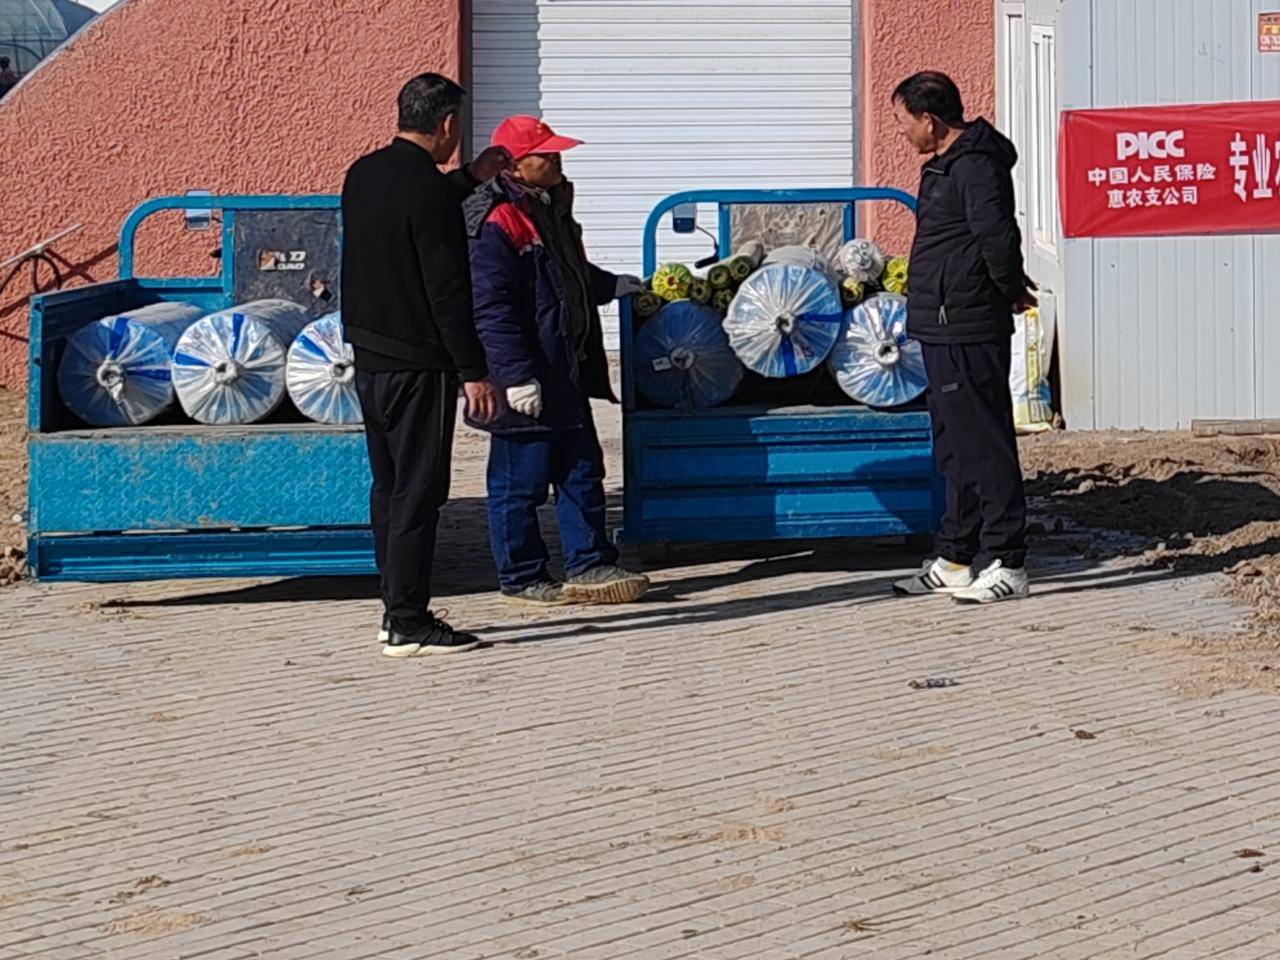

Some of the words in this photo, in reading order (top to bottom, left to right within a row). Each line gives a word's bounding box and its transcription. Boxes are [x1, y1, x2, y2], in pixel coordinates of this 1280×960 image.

[1116, 130, 1185, 160] PICC
[1087, 162, 1217, 187] 中国人民保险
[1107, 186, 1198, 209] 惠农支公司
